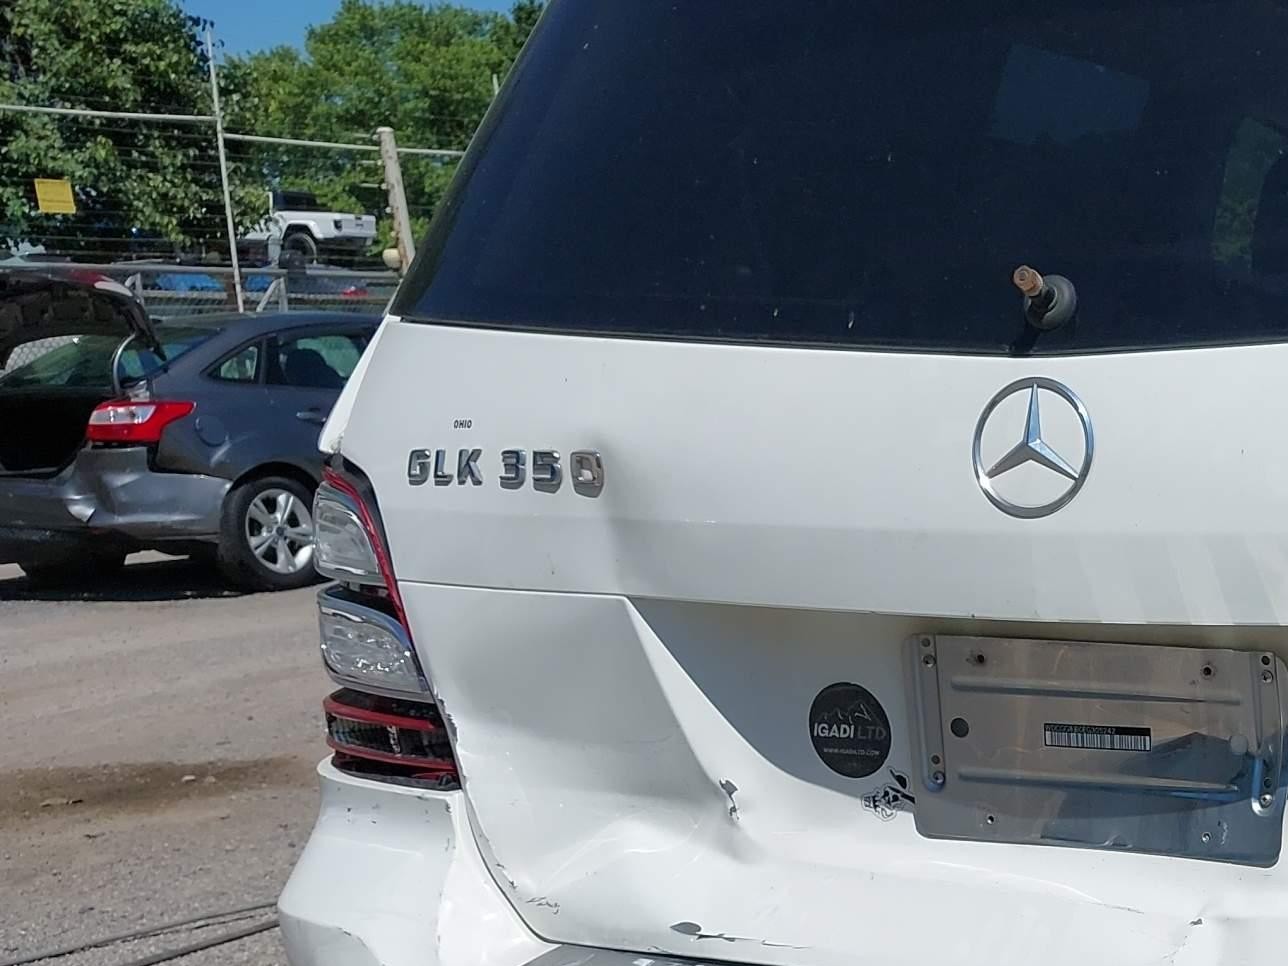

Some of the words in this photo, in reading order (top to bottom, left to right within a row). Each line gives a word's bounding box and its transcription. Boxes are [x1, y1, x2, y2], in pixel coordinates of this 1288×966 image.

[453, 419, 473, 429] OHIO
[408, 448, 483, 486] GLK
[499, 448, 605, 499] 350
[813, 722, 856, 739] IGADI
[857, 725, 887, 740] LTD
